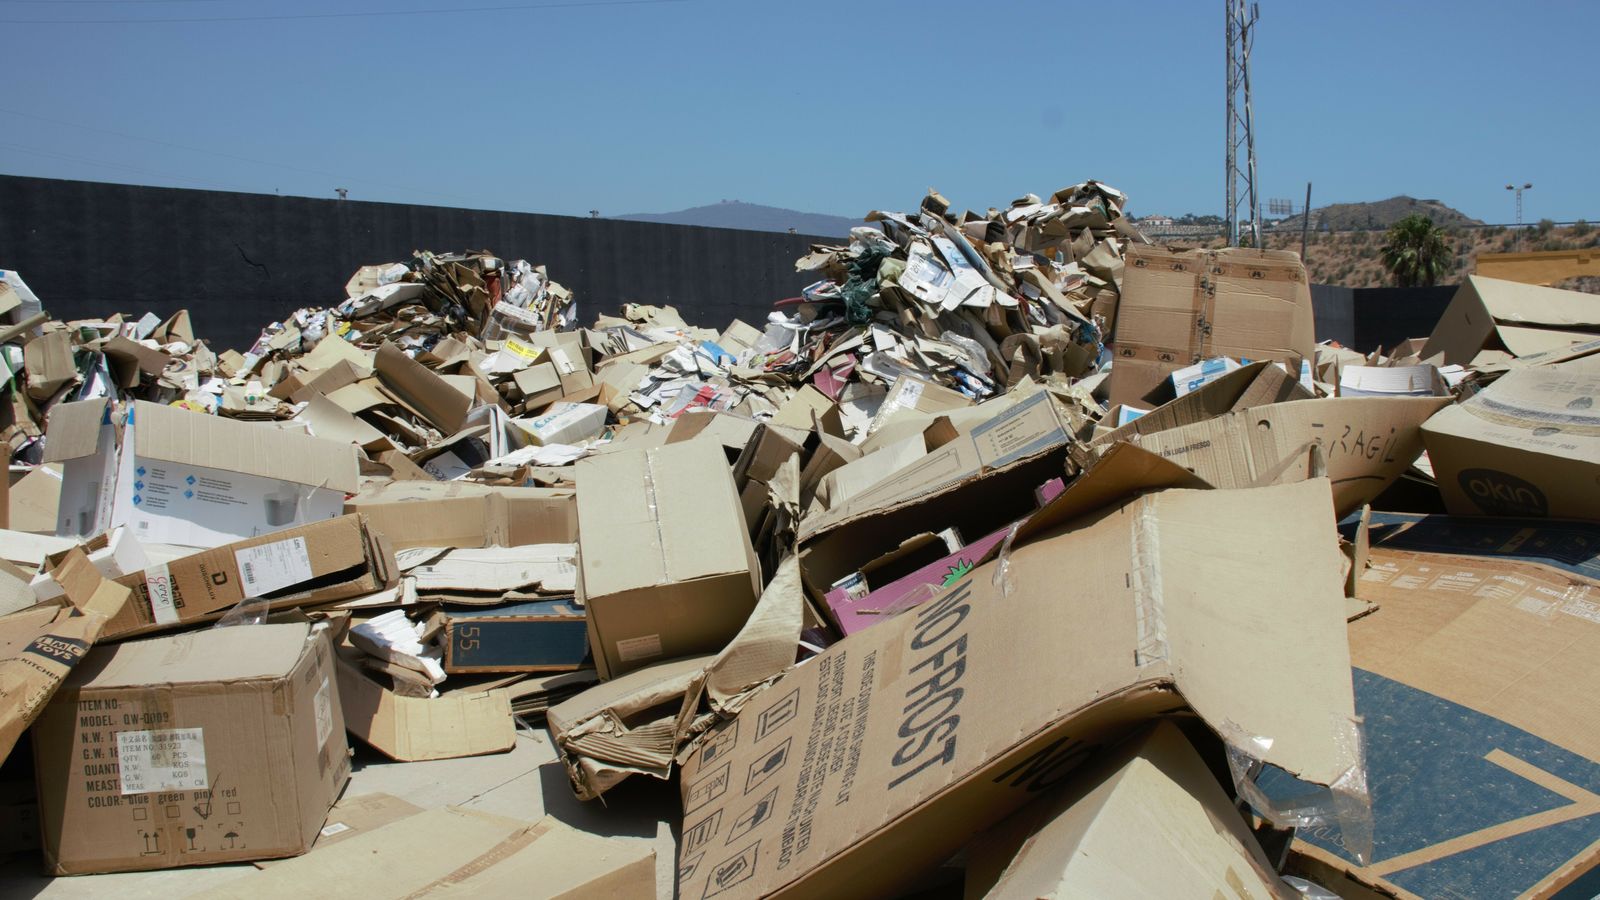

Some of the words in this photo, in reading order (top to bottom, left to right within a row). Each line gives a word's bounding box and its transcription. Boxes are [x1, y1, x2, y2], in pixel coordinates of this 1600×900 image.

[911, 578, 973, 650] NO
[21, 658, 60, 681] KITCHEN
[79, 699, 101, 711] ITEM
[887, 633, 968, 790] FROST
[158, 792, 185, 804] green
[194, 789, 213, 799] pink
[221, 787, 237, 797] red
[794, 813, 813, 857] UNTEN
